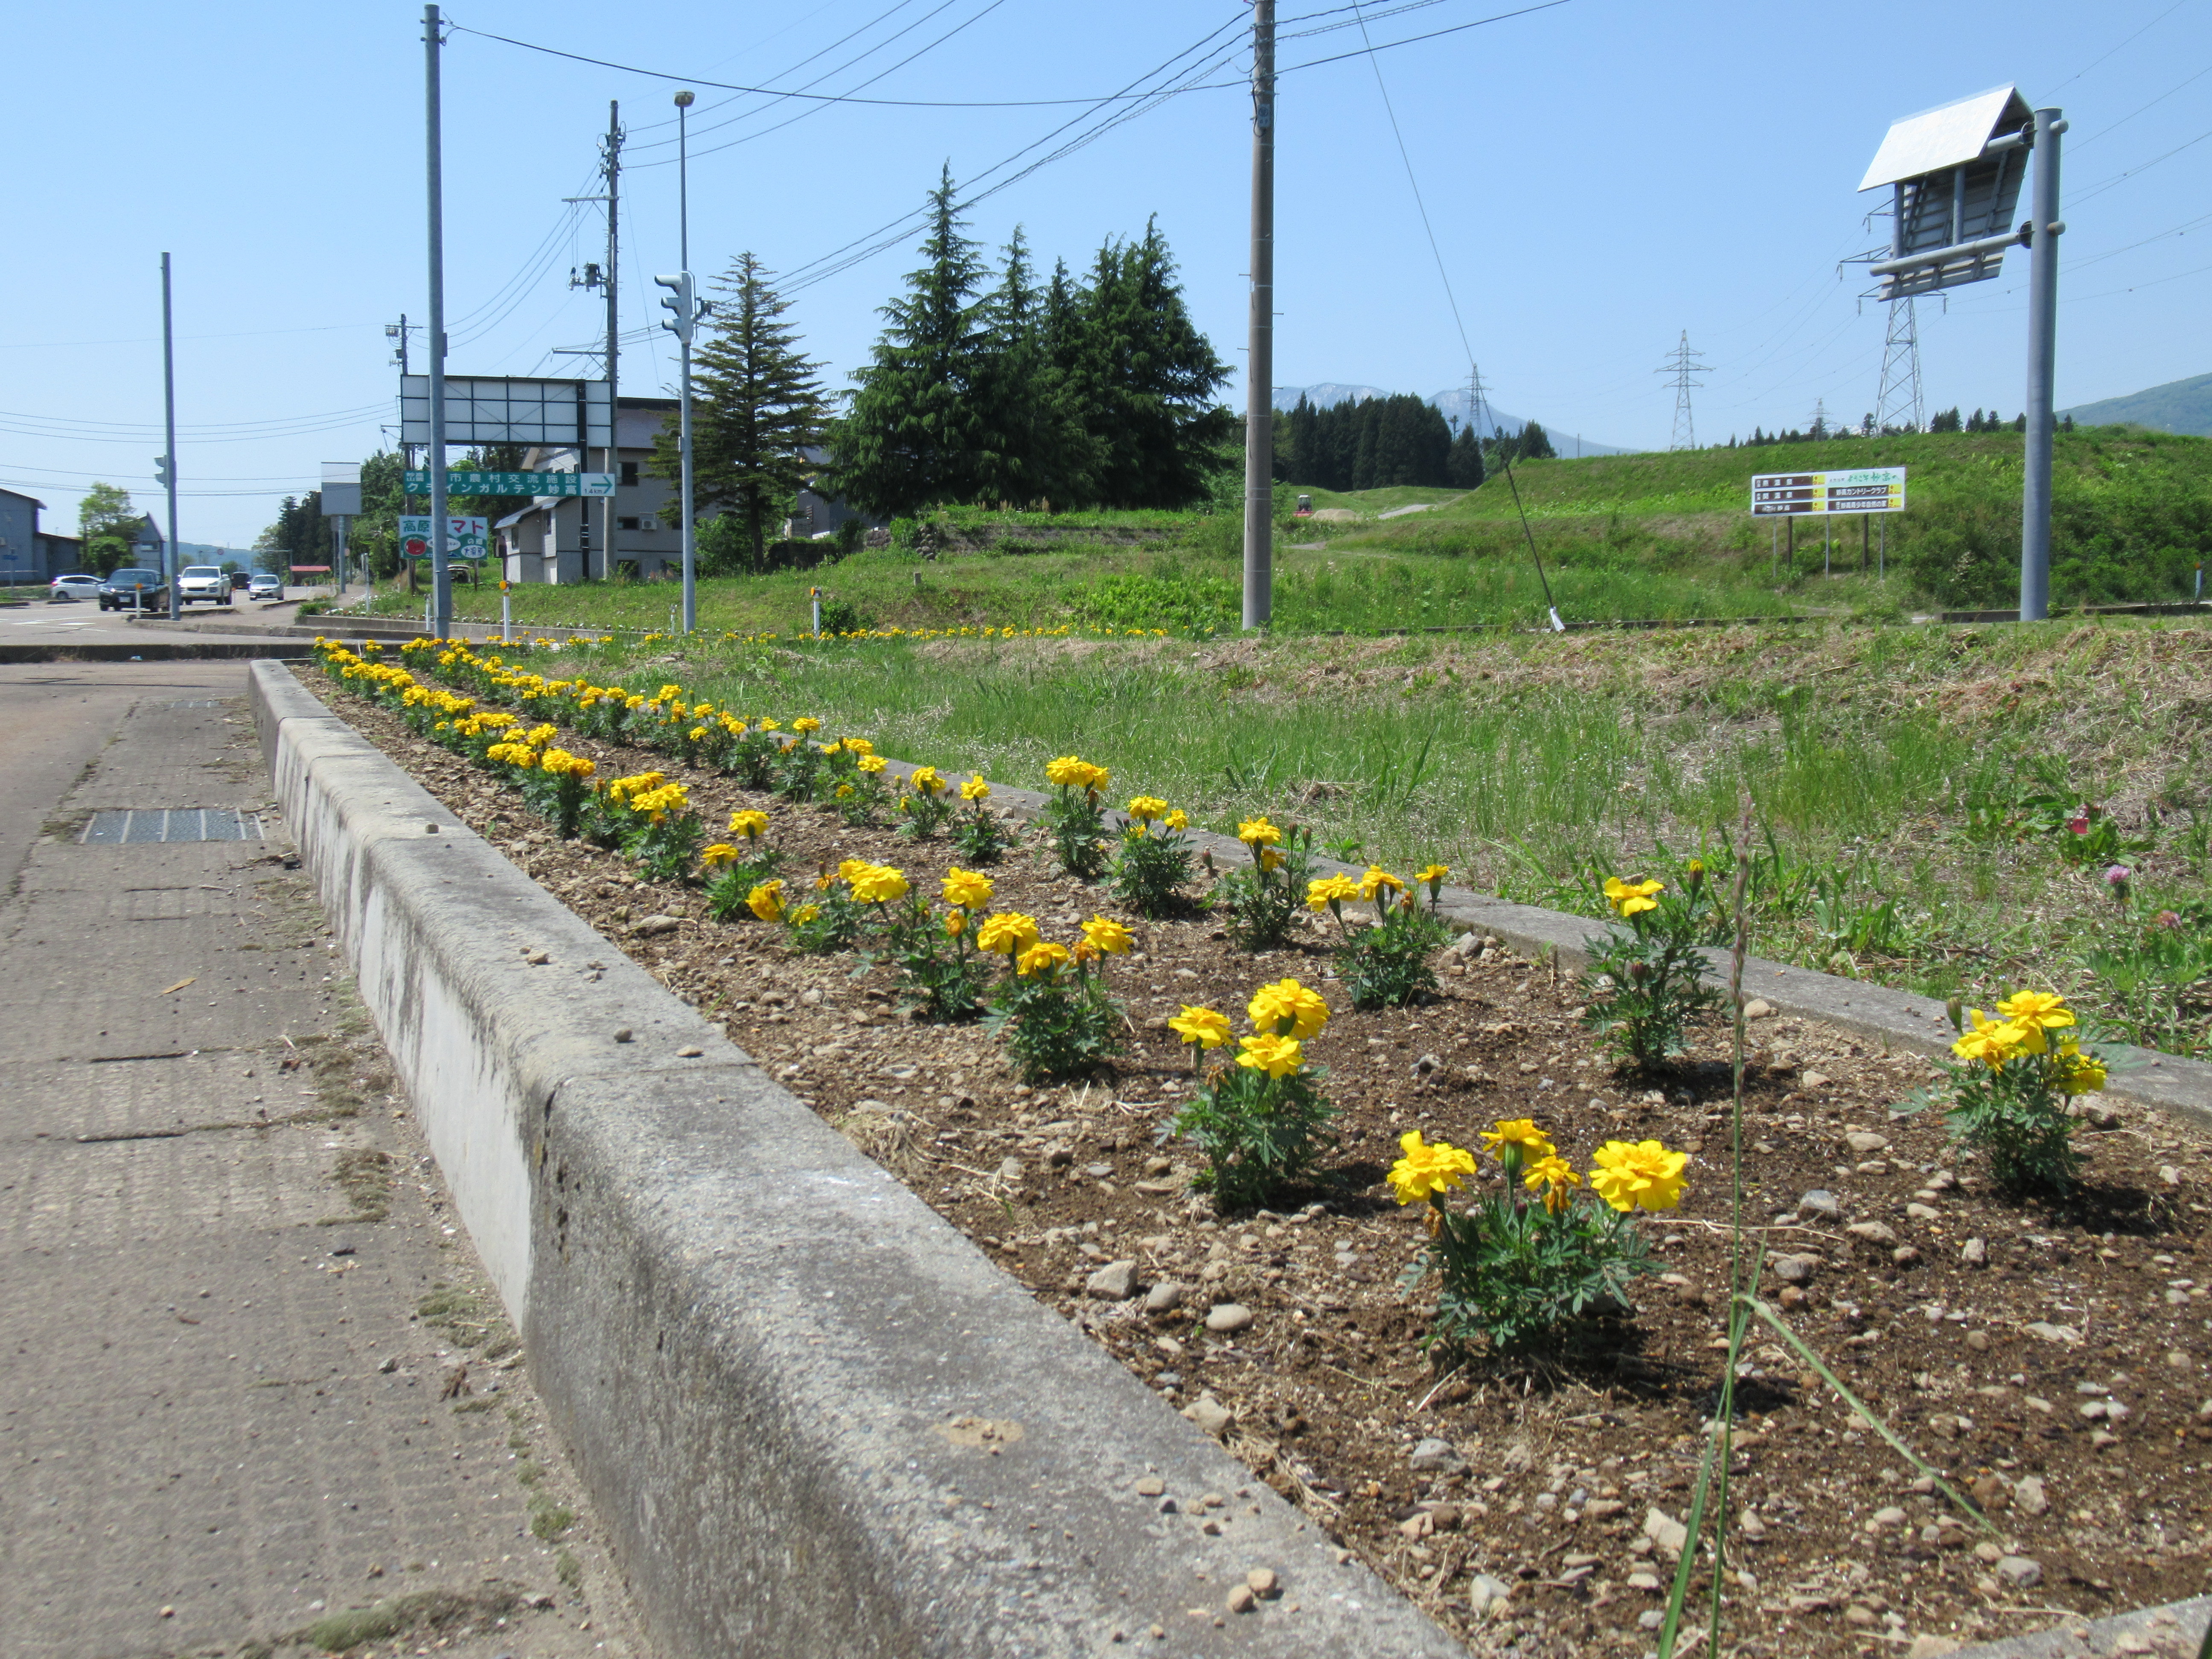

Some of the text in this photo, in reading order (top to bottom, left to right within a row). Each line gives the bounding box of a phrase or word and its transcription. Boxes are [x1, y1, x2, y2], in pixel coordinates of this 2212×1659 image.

[430, 473, 577, 484] 市農村交流施設
[403, 519, 484, 534] 高原マト
